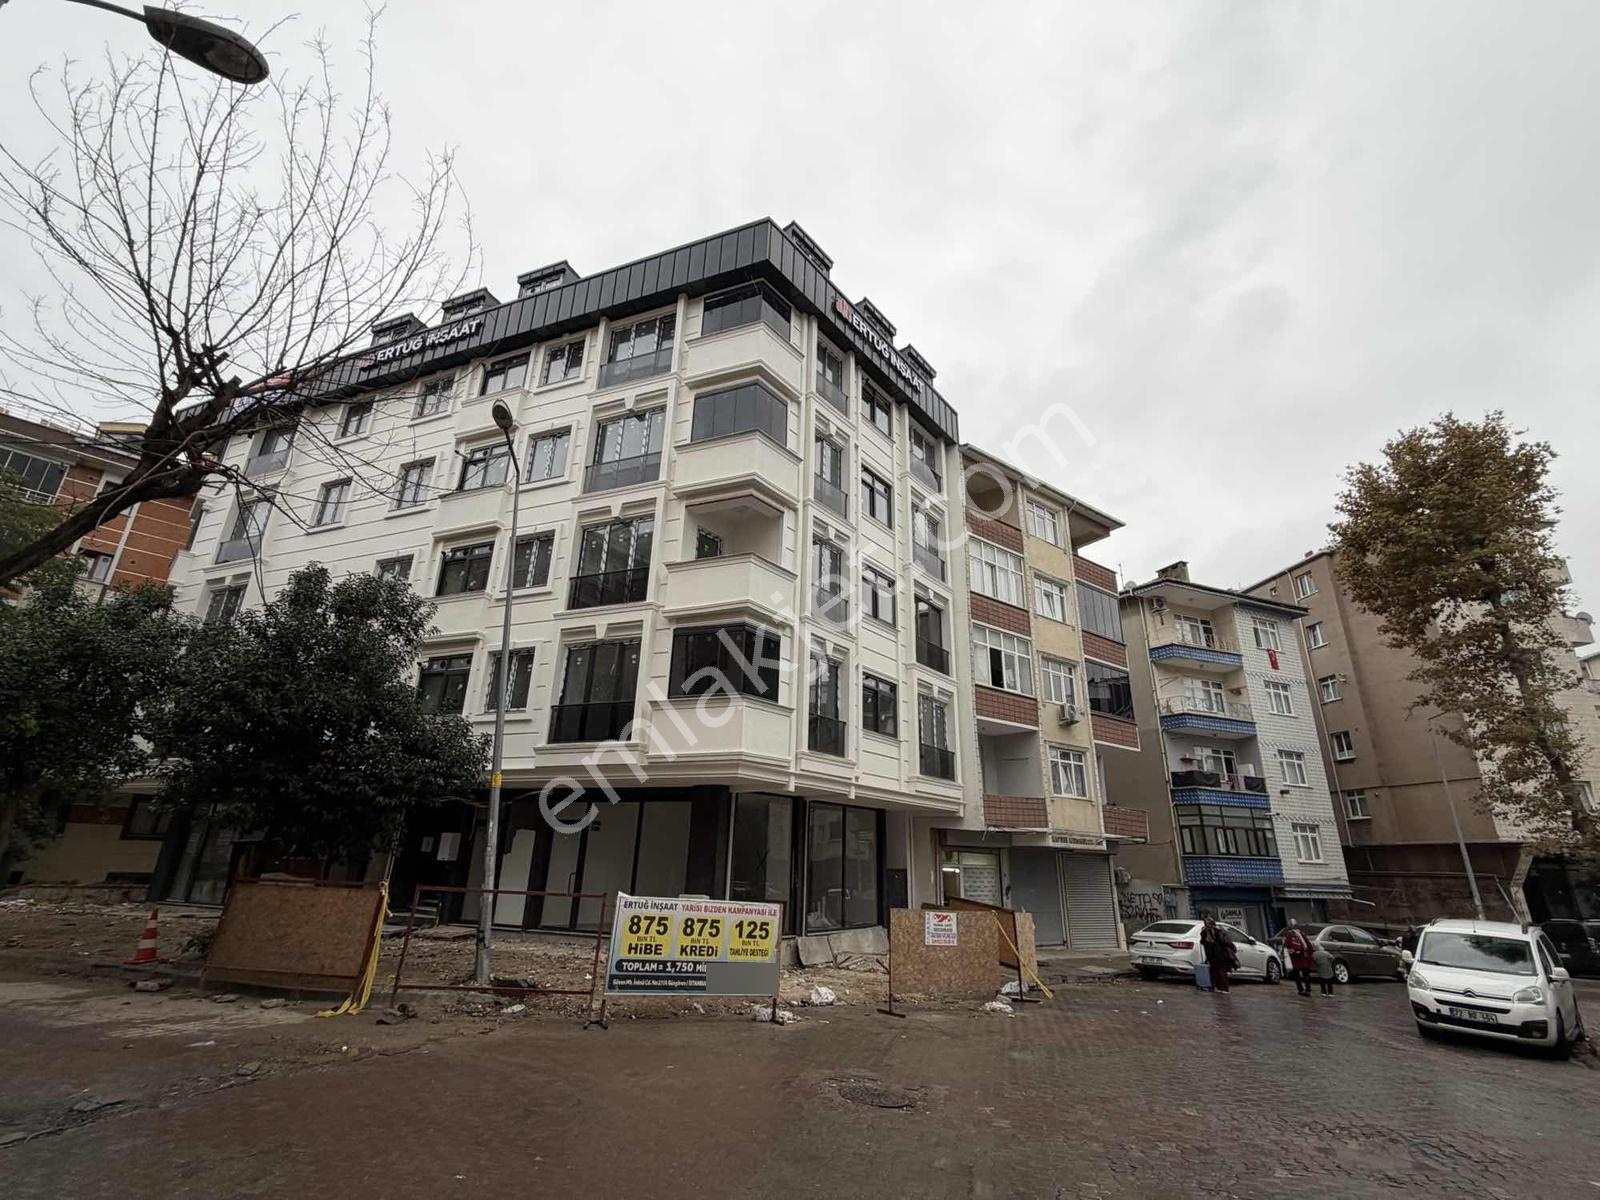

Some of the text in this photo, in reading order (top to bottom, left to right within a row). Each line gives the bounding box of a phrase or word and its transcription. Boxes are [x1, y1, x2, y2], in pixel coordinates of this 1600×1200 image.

[623, 900, 678, 912] ERTUĞ İNŞAAT
[628, 914, 669, 935] 875
[682, 917, 721, 938] 875
[735, 920, 770, 940] 125
[628, 943, 663, 955] HİBE
[680, 945, 718, 957] KREDİ
[622, 962, 657, 972] TOPLAM
[666, 962, 693, 975] 1,750
